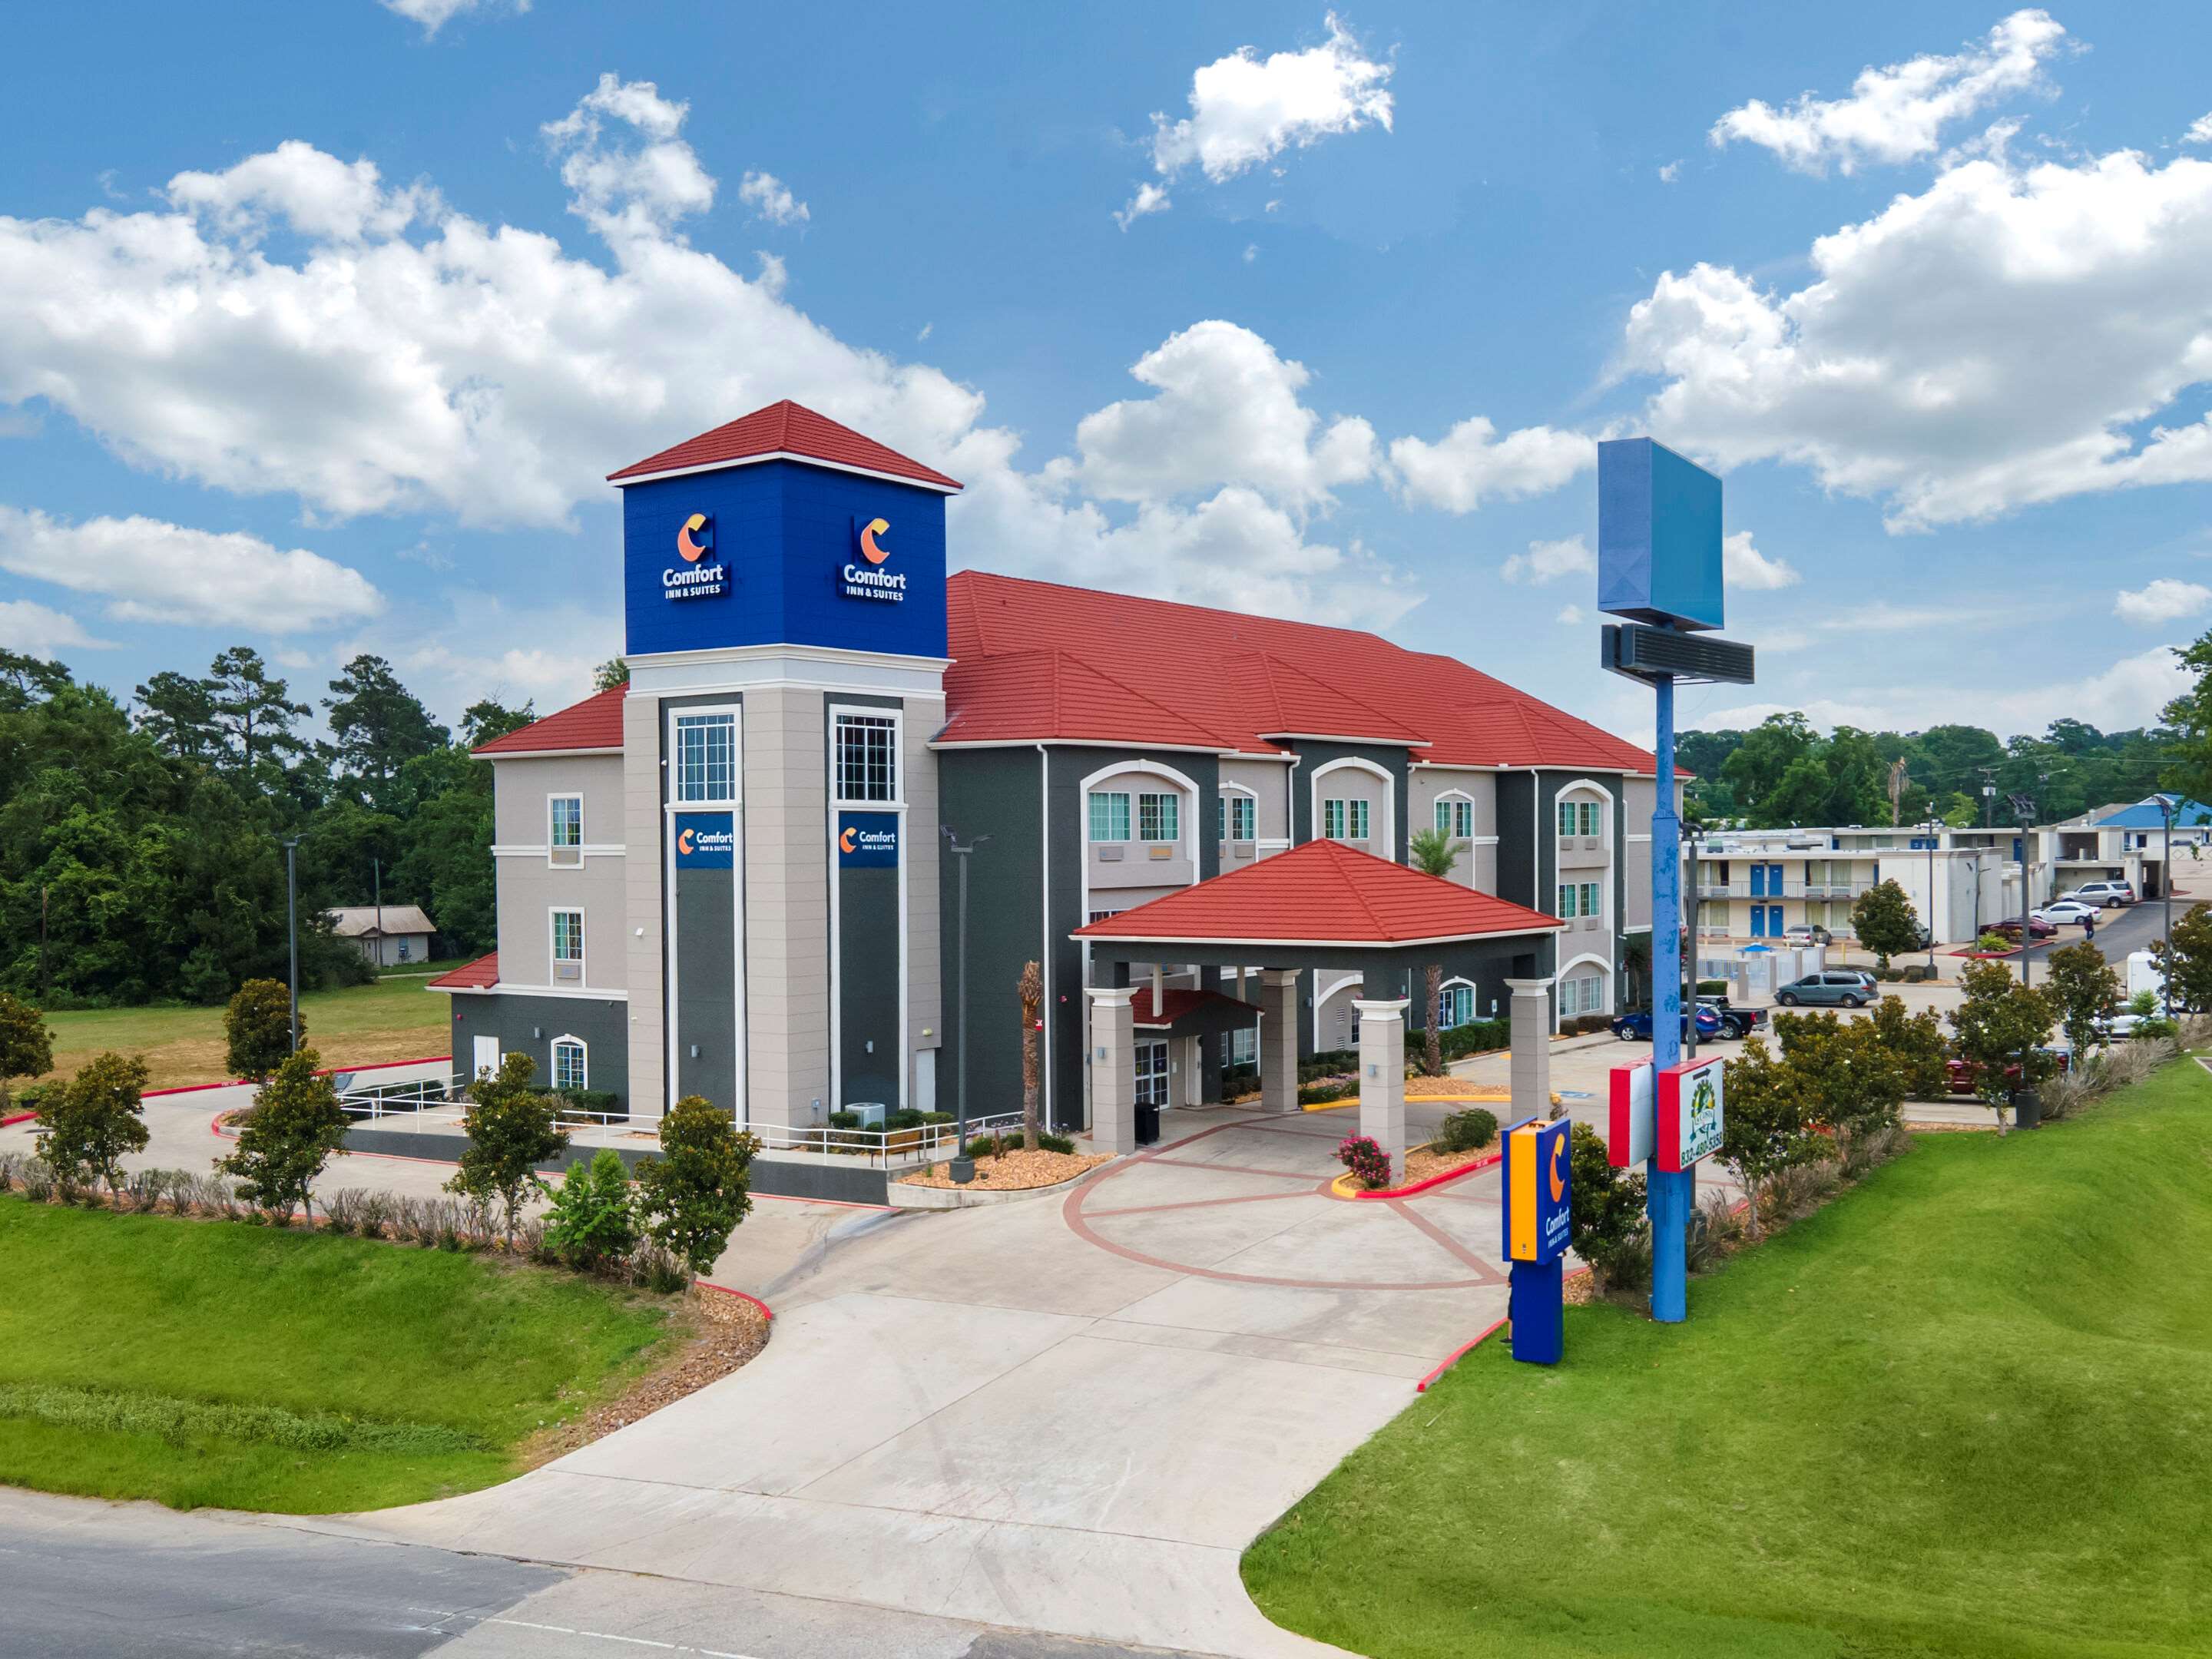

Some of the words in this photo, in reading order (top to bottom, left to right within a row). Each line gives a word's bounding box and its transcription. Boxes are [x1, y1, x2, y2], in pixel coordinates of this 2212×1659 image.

[663, 564, 724, 587] Comfort
[843, 565, 906, 590] Comfort
[665, 588, 681, 599] INN
[682, 588, 690, 597] &
[690, 584, 720, 596] SUITES
[846, 585, 864, 596] INN
[865, 588, 873, 598] &
[873, 589, 903, 601] SUITES
[696, 831, 733, 843] Comfort
[859, 830, 896, 843] Comfort
[1545, 1206, 1570, 1236] Comfort
